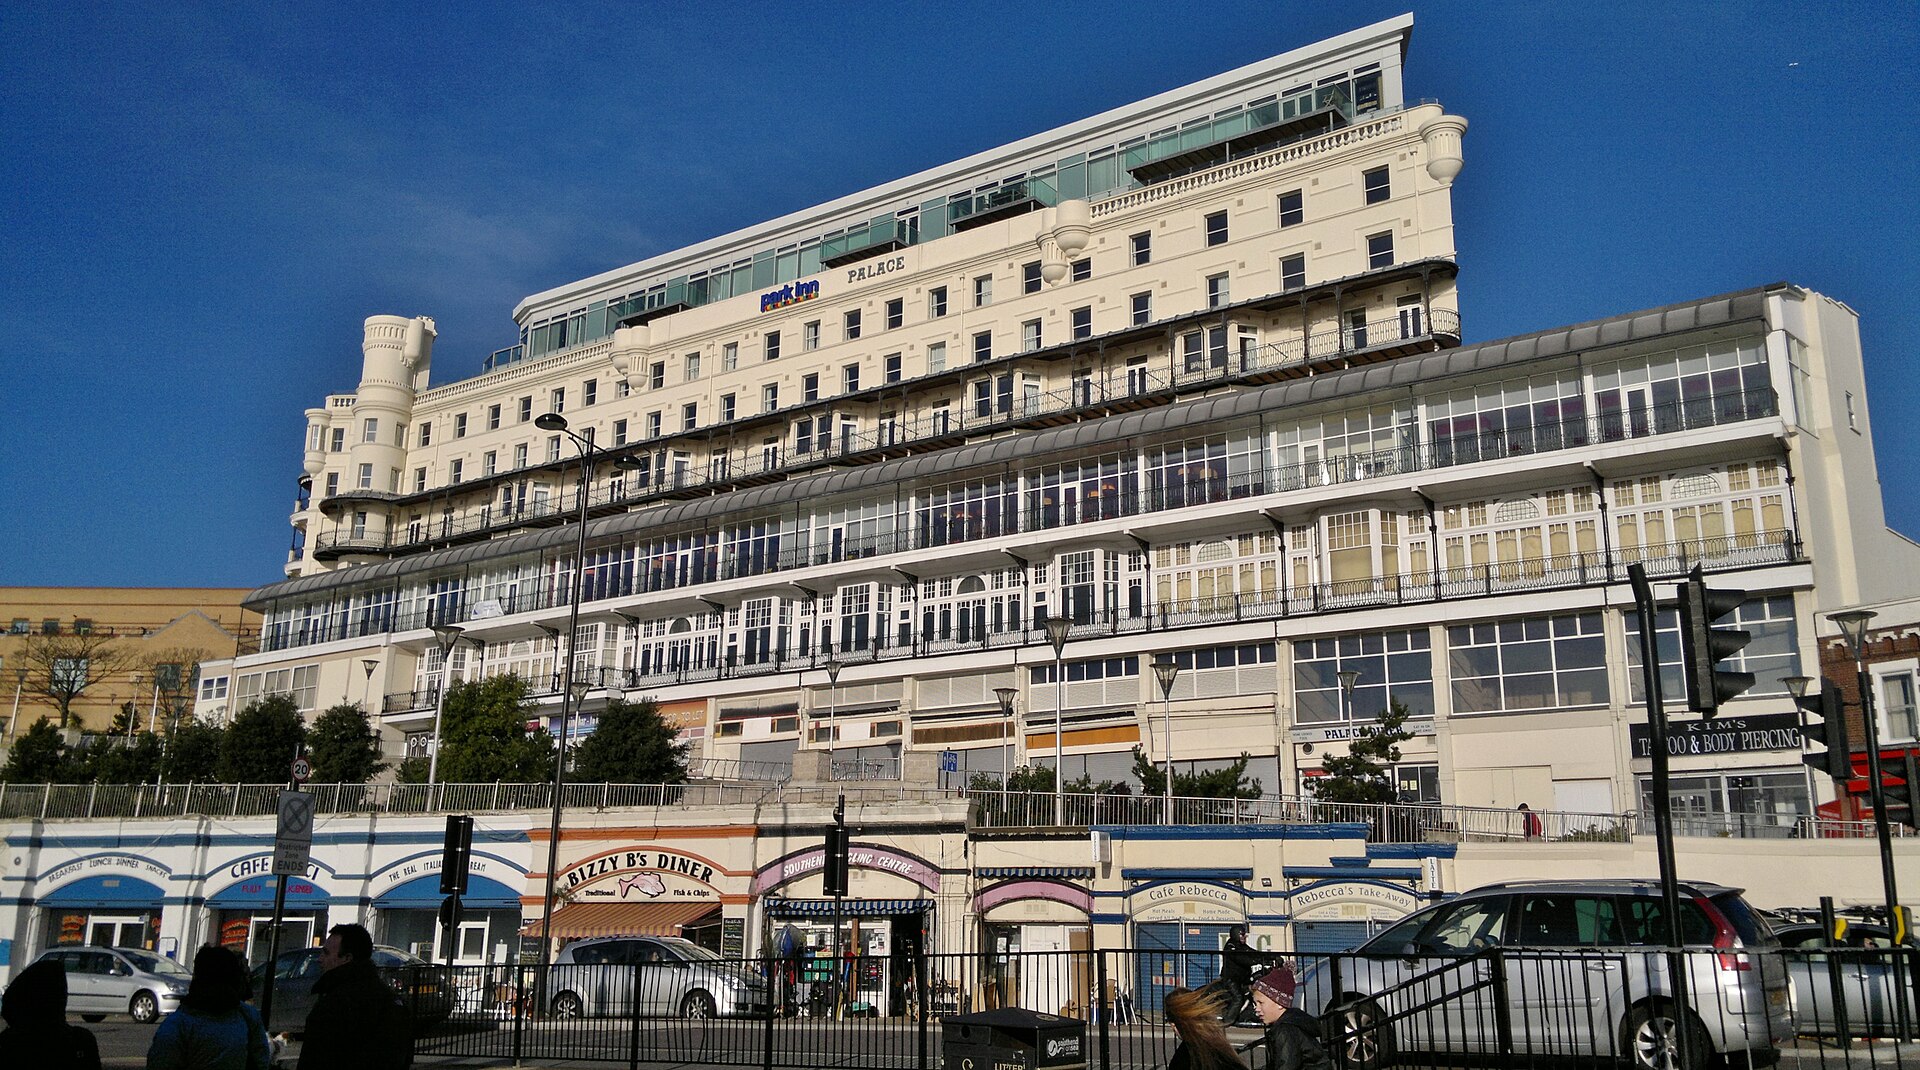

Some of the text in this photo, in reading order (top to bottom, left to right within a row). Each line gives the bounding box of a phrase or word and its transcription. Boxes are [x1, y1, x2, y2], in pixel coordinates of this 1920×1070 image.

[847, 256, 906, 284] PALACE
[760, 279, 820, 313] park inn
[1324, 727, 1367, 739] PALAC
[1686, 719, 1747, 731] KIM'S
[1690, 735, 1701, 754] &
[1703, 732, 1737, 753] BODY
[1741, 727, 1800, 750] PIERCING
[294, 764, 308, 775] 20
[284, 851, 299, 860] Zone
[48, 857, 168, 883] BREAKFAST LUNCH DINNER SNACKS
[231, 857, 269, 878] CAFE
[277, 860, 304, 871] ENDS
[388, 859, 487, 882] THE REAL ITALIA REAM
[567, 855, 619, 887] BIZZY
[657, 853, 714, 884] DINER
[877, 856, 913, 875] CENTRE
[584, 889, 616, 897] Traditional
[673, 889, 686, 897] Fish
[692, 889, 710, 898] Chips
[1179, 884, 1228, 901] Rebecca
[1297, 885, 1411, 907] Rebecca's Take-Away
